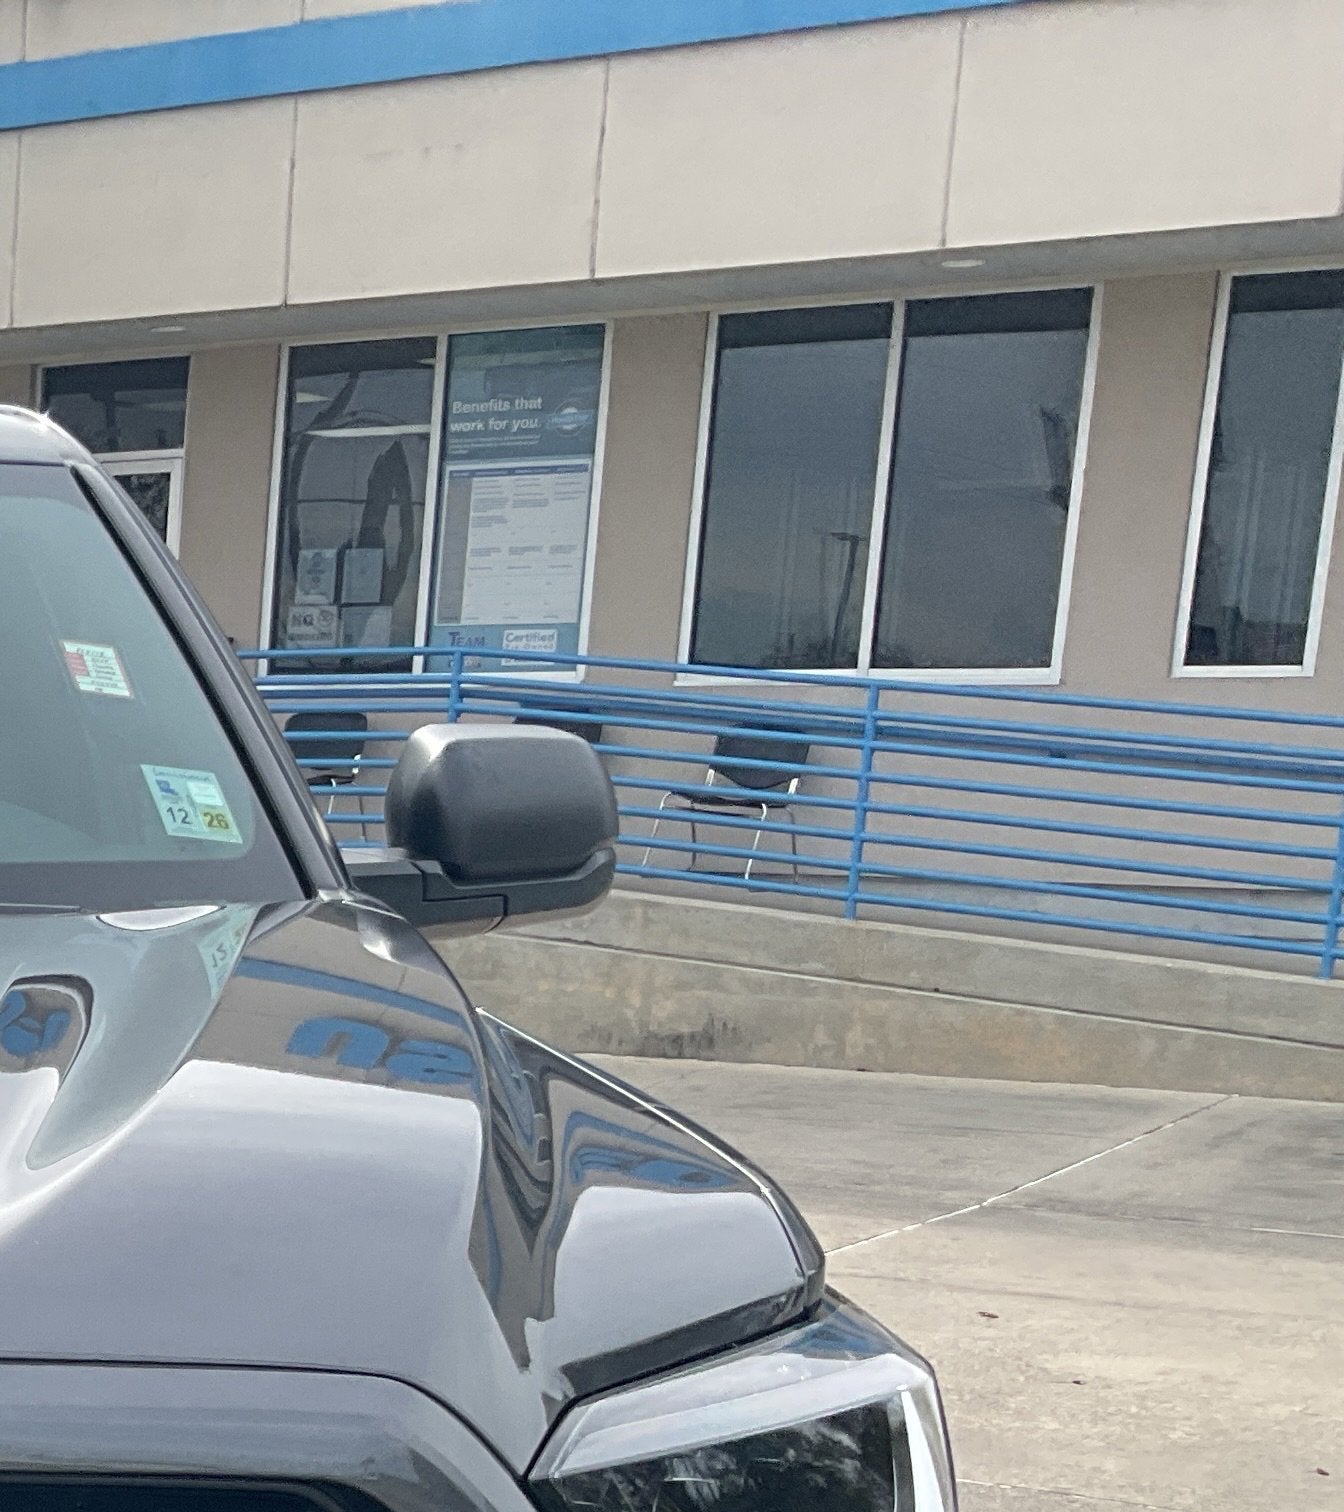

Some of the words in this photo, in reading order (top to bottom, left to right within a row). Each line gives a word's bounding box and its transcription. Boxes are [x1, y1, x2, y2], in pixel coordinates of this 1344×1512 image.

[452, 398, 511, 415] Benefits
[514, 396, 543, 410] that
[450, 419, 485, 433] work
[488, 417, 509, 430] for
[448, 631, 485, 647] TEAM
[504, 631, 556, 643] Certified
[166, 806, 192, 825] 12
